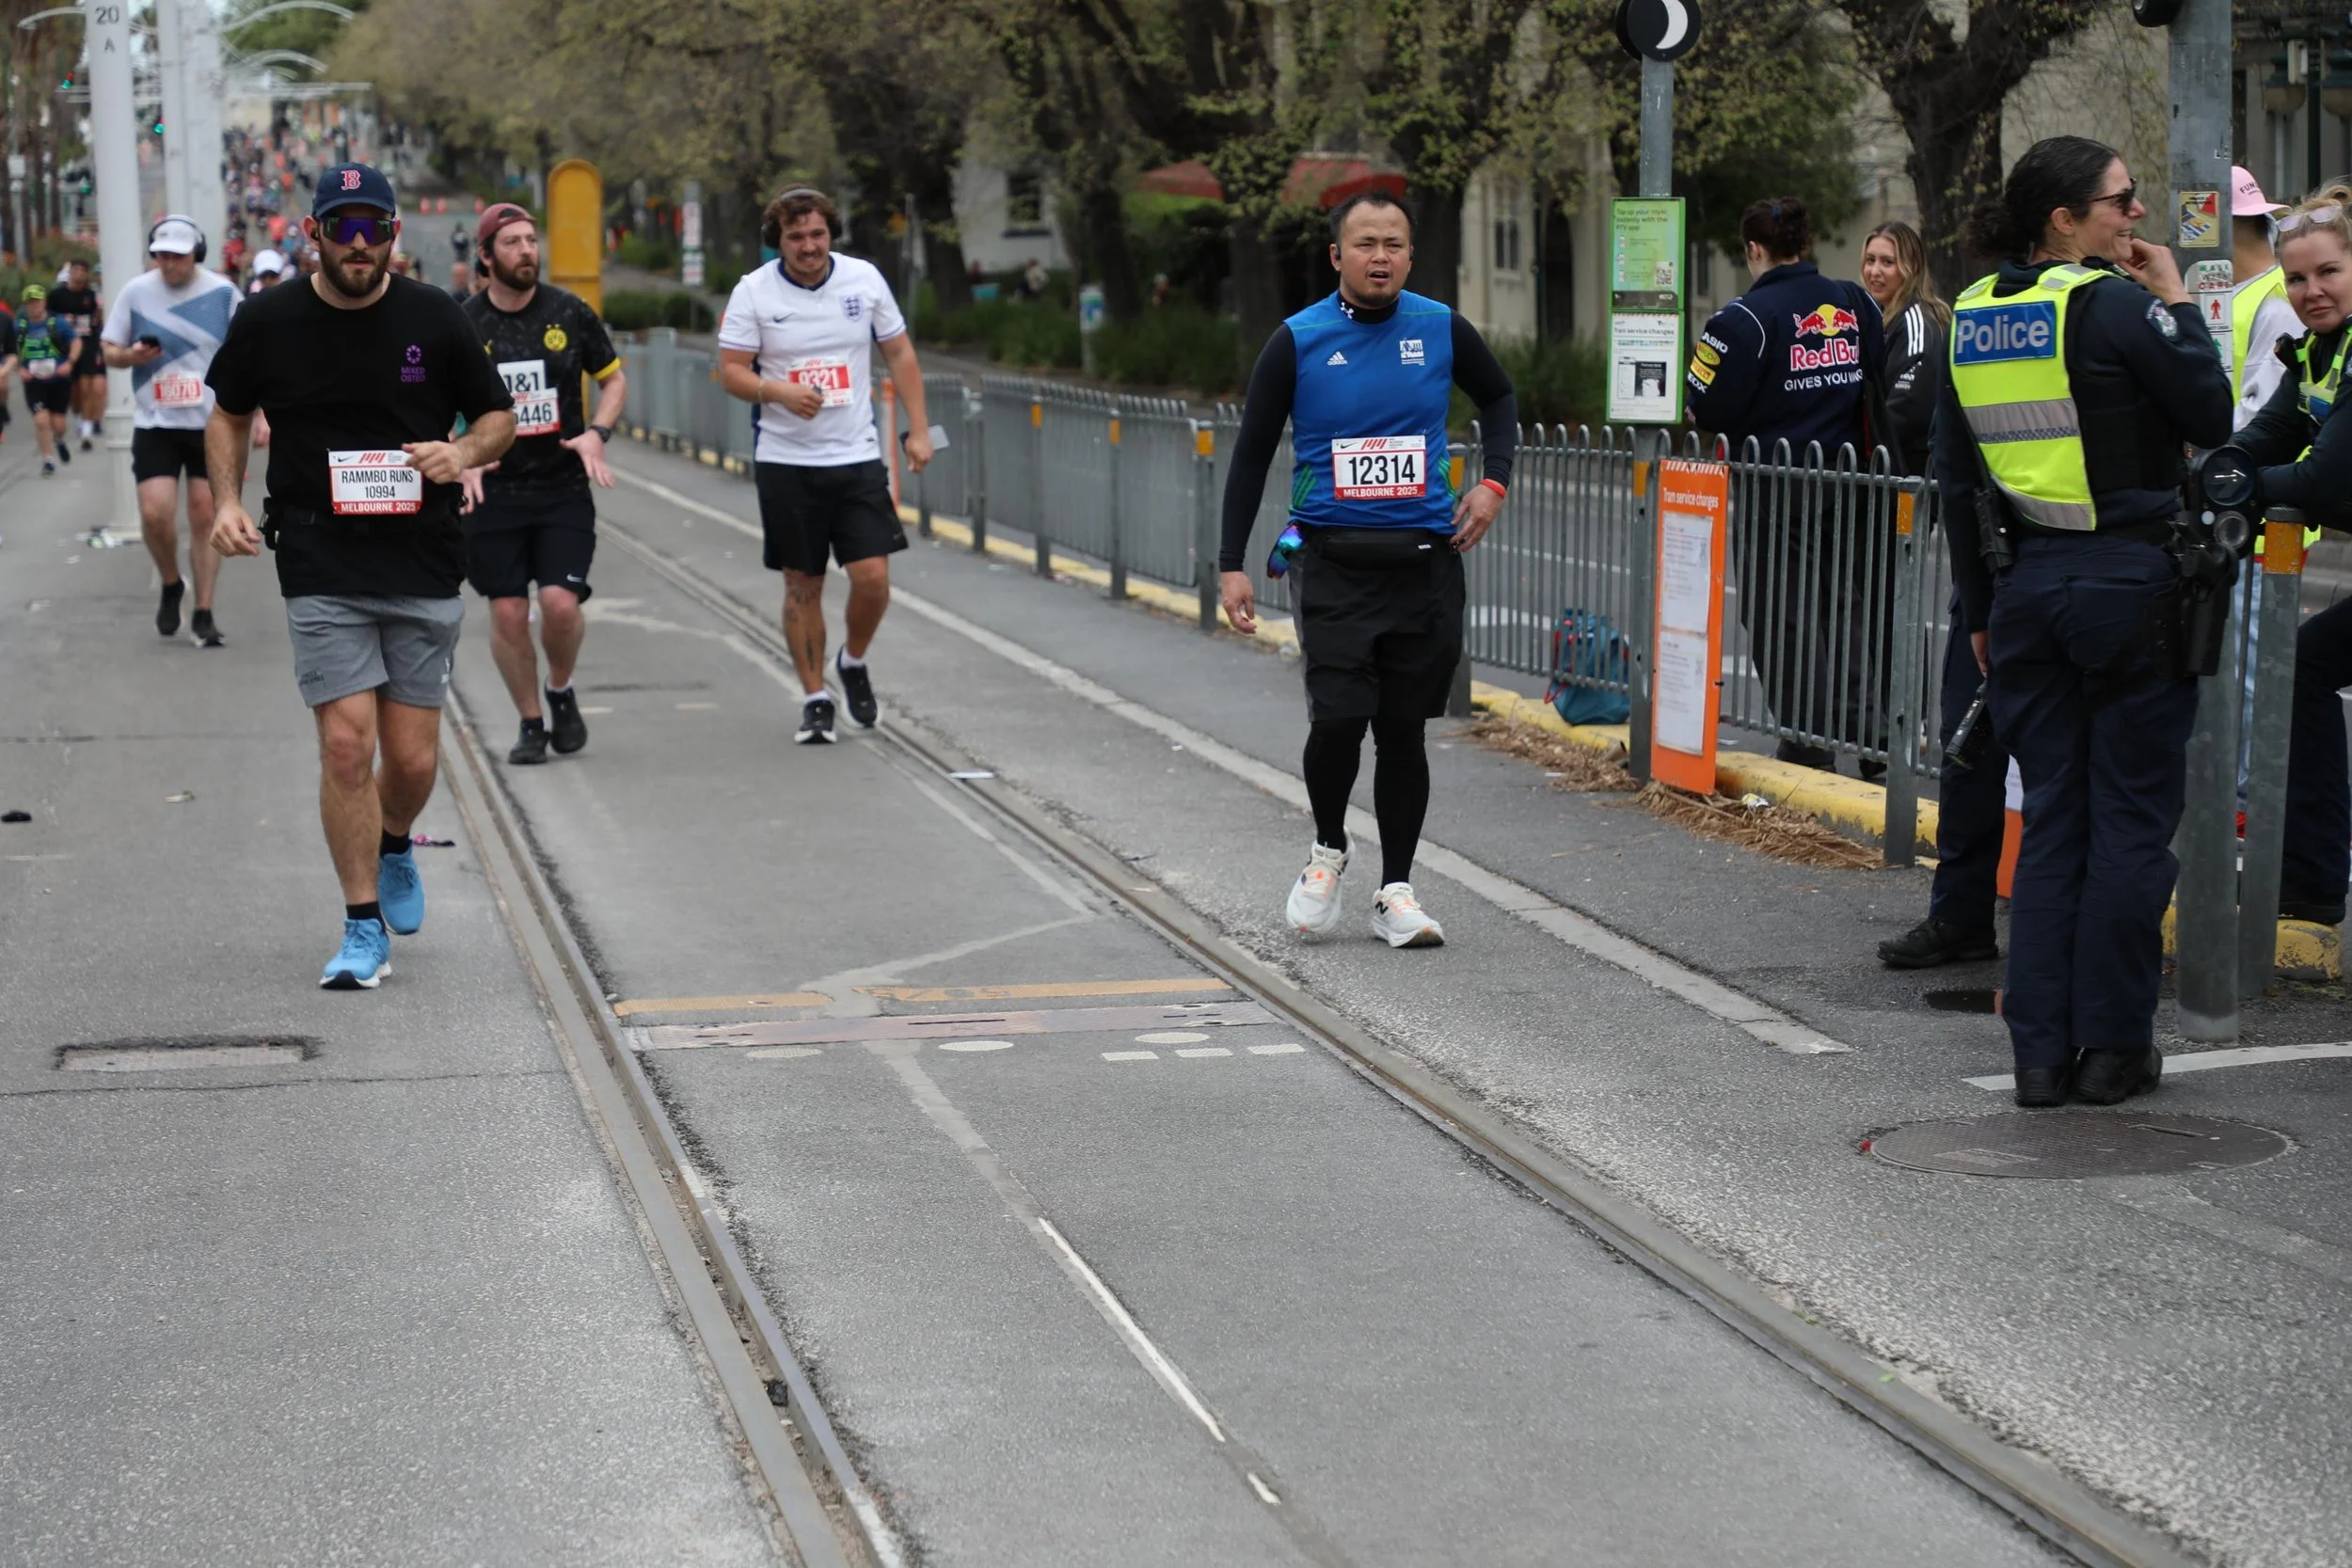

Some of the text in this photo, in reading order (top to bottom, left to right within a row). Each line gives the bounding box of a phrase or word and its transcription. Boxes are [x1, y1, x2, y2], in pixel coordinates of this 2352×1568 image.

[95, 5, 119, 25] 20
[104, 38, 116, 53] A
[341, 169, 361, 191] B
[1701, 331, 1728, 354] ASIO
[1956, 315, 2050, 354] Police
[1790, 338, 1836, 372] Red
[1687, 371, 1708, 393] EOX
[1784, 375, 1822, 391] GIVES
[1823, 372, 1848, 386] YOU
[342, 469, 414, 483] RAMMBO RUNS
[1348, 454, 1415, 485] 12314
[364, 485, 395, 499] 10994
[1343, 486, 1418, 498] MELBOURNE 2025
[1677, 489, 1695, 505] service
[1696, 491, 1719, 511] changes
[341, 501, 416, 513] MELBOURNE 2025
